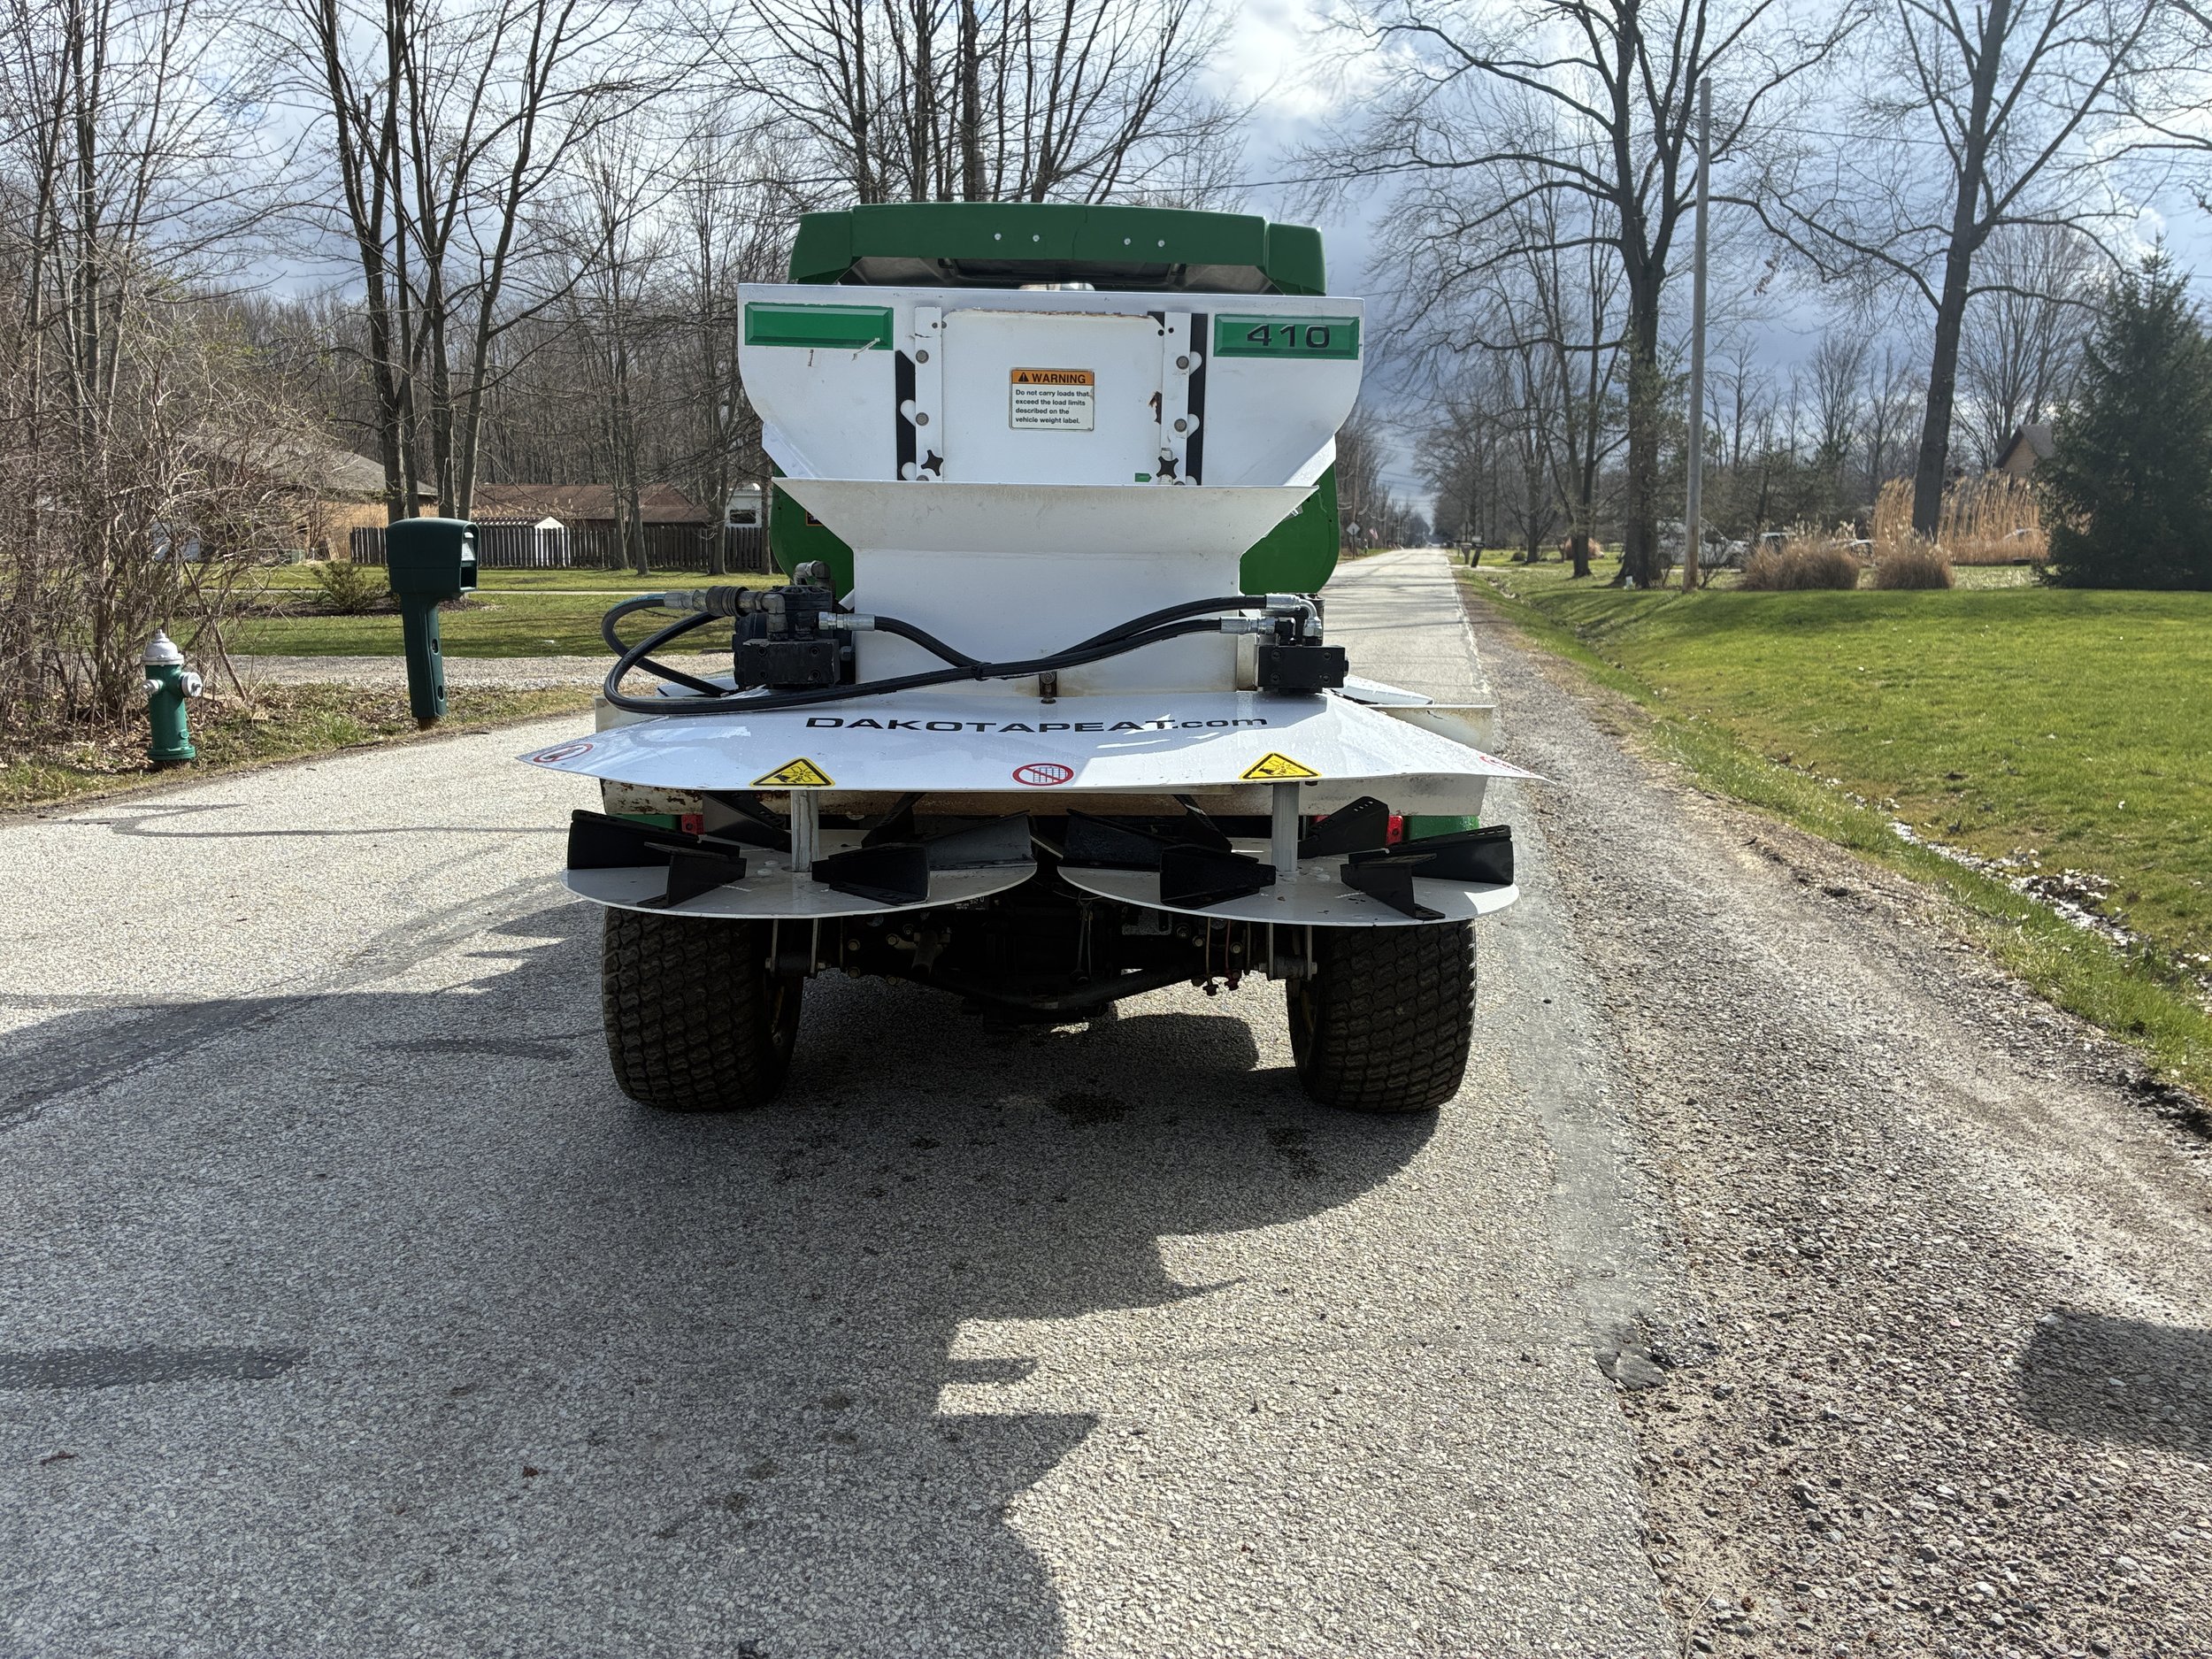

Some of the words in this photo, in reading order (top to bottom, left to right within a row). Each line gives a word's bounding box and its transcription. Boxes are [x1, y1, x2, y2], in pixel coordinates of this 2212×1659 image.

[1247, 324, 1330, 349] 410
[1032, 373, 1086, 383] WARNING
[805, 717, 1268, 733] DAKOTAPEAT.com
